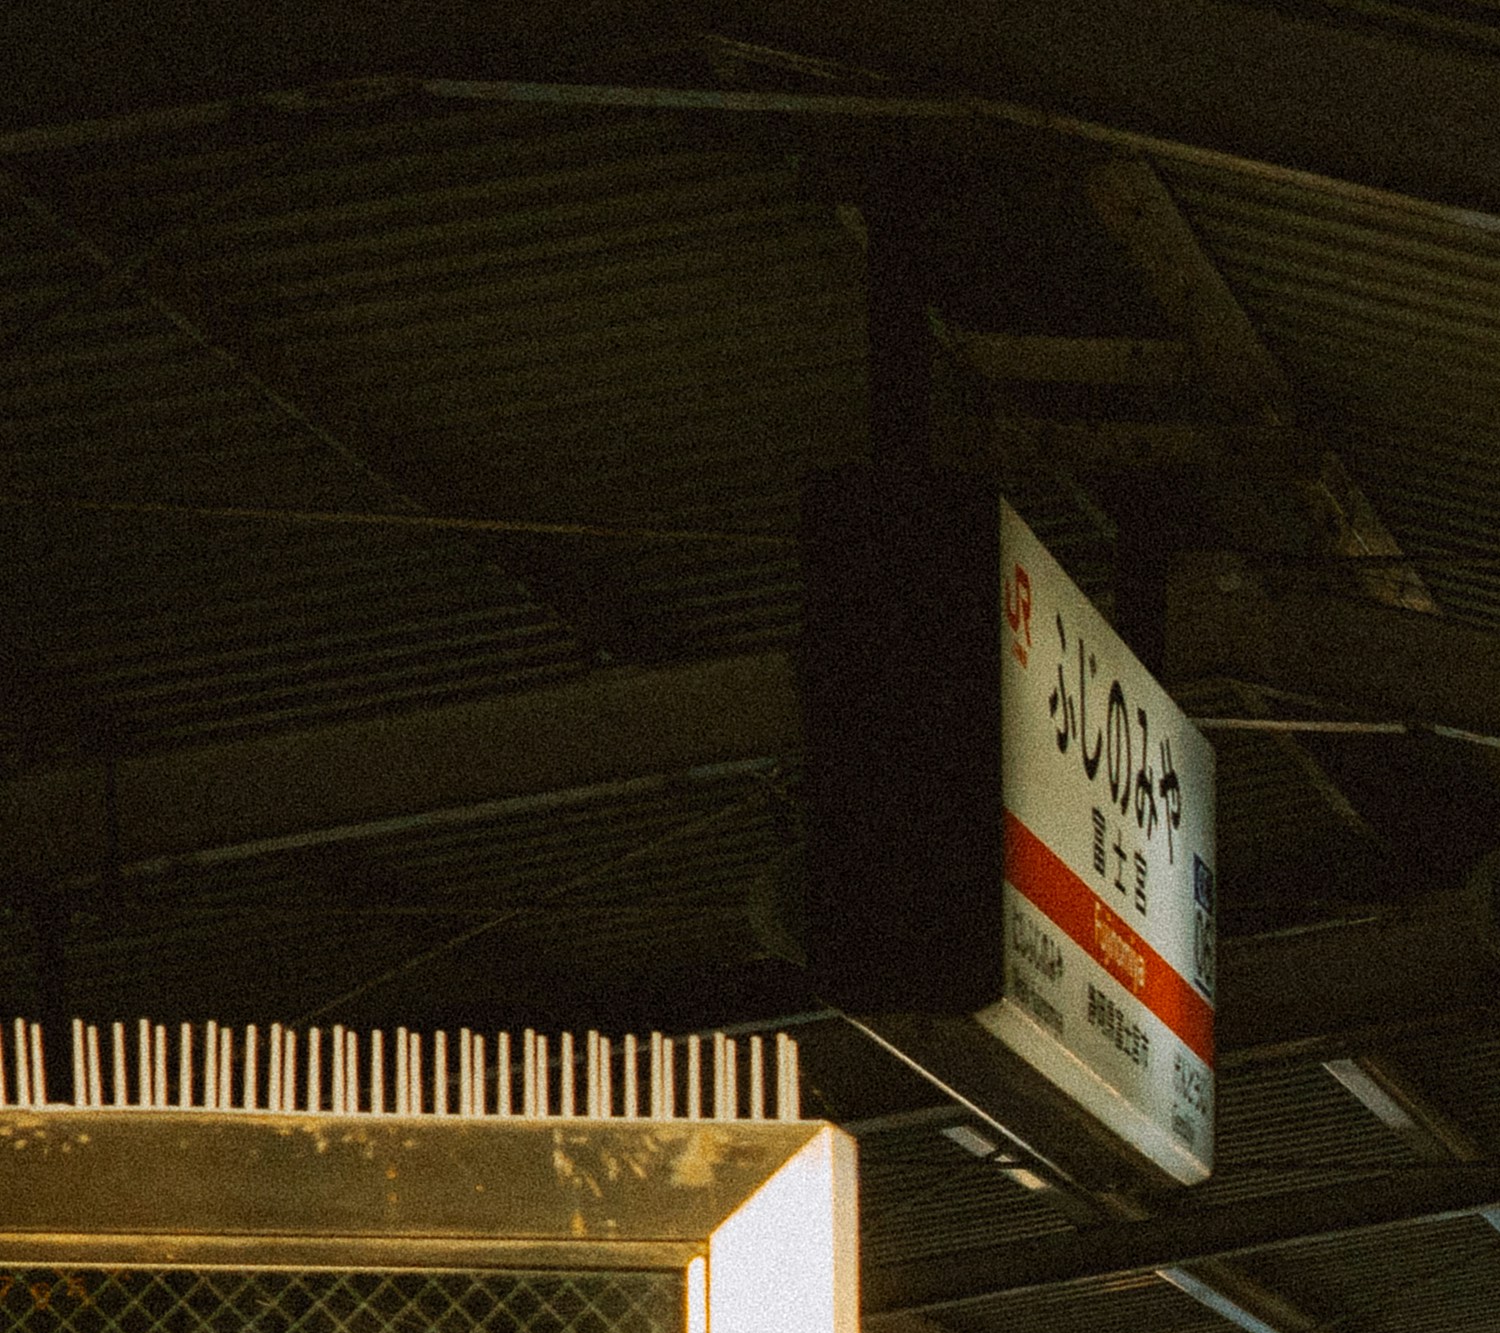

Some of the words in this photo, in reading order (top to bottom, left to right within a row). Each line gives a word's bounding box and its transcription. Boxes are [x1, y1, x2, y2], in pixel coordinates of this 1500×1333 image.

[1005, 563, 1032, 650] JR
[1048, 612, 1181, 866] ふじのみや
[1092, 806, 1147, 918] 富士宮
